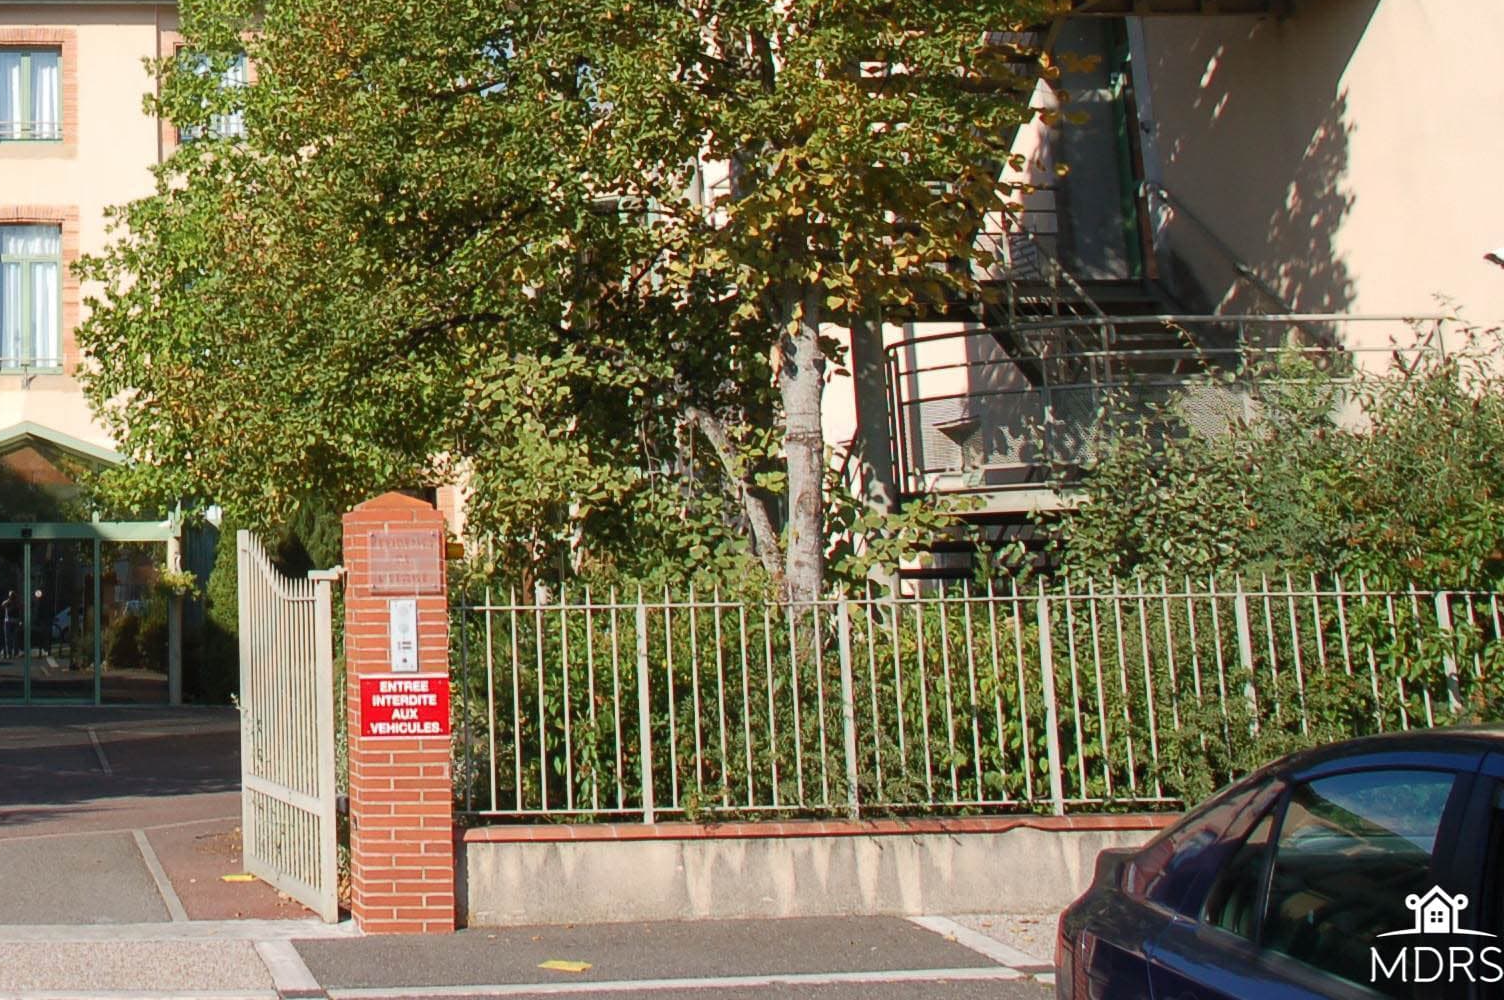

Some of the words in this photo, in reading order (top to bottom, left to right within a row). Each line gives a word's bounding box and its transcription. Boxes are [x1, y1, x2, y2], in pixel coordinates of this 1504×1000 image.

[379, 680, 429, 692] ENTREE
[372, 694, 437, 706] INTERDITE
[391, 708, 418, 720] AUX
[370, 721, 440, 734] VEHICULES
